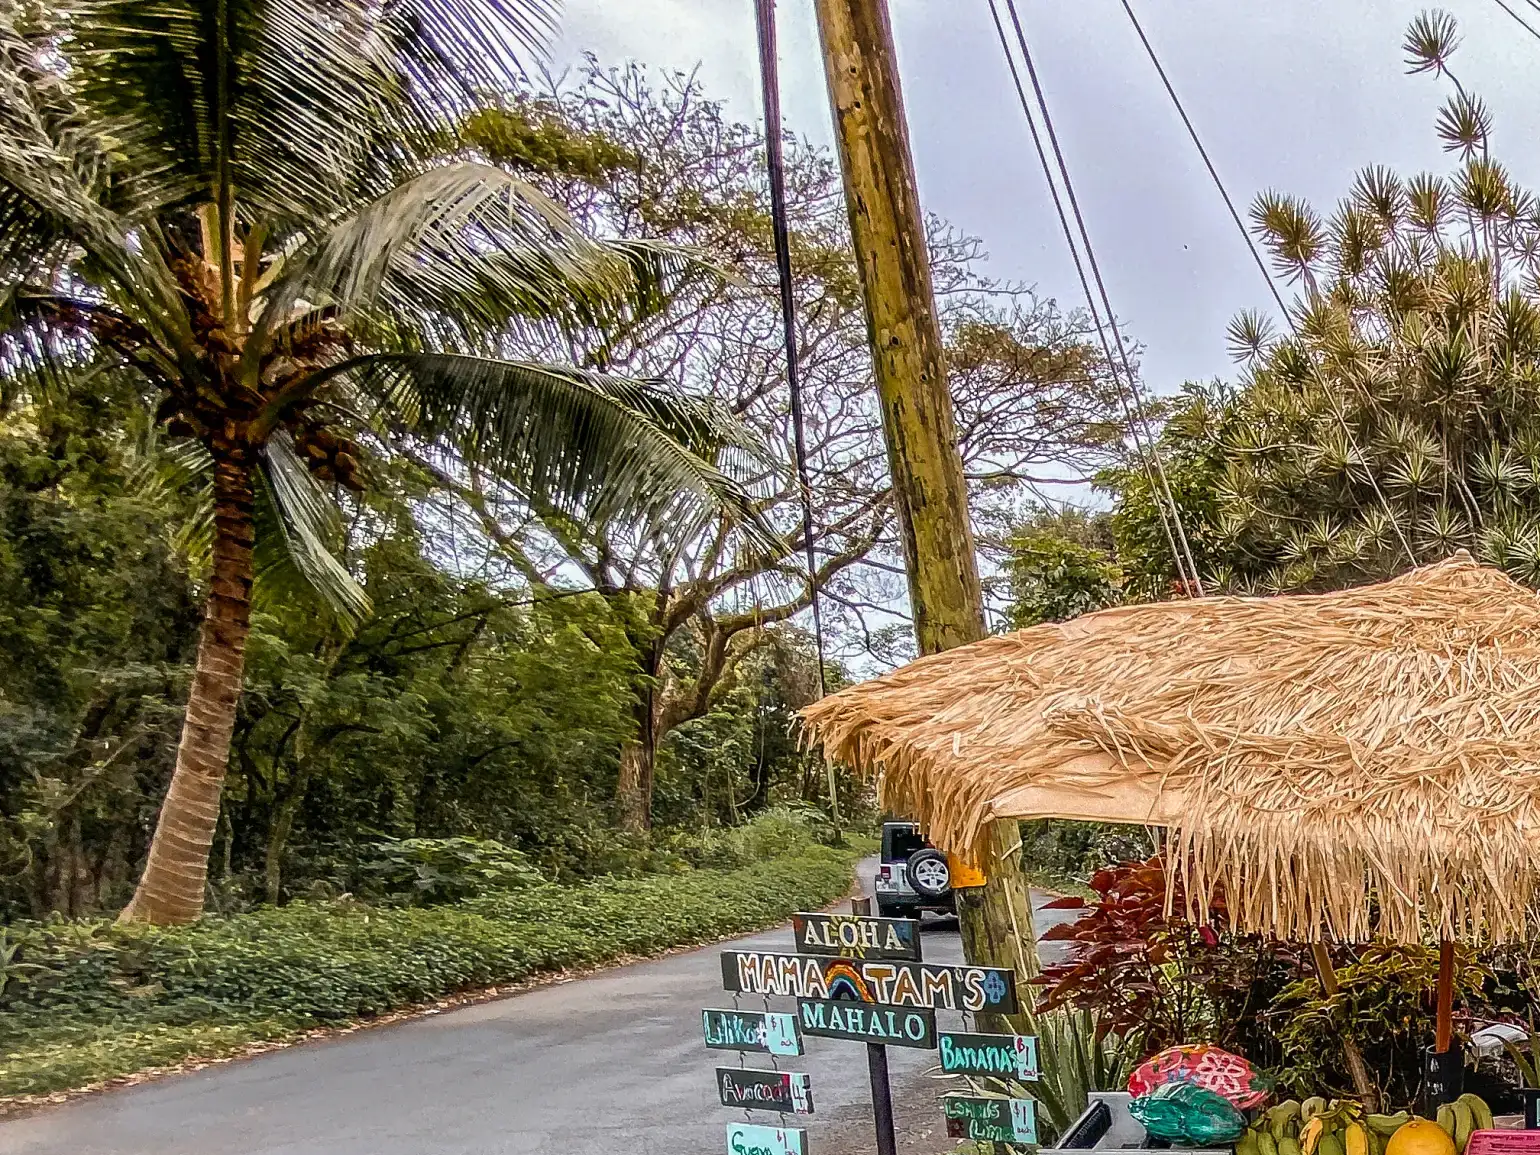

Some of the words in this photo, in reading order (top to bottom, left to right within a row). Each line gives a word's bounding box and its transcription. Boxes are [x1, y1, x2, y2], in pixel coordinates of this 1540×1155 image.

[804, 920, 905, 950] ALOHA
[737, 953, 829, 999] MAMA
[862, 963, 986, 1012] TAM'S
[801, 1002, 925, 1041] MAHALO
